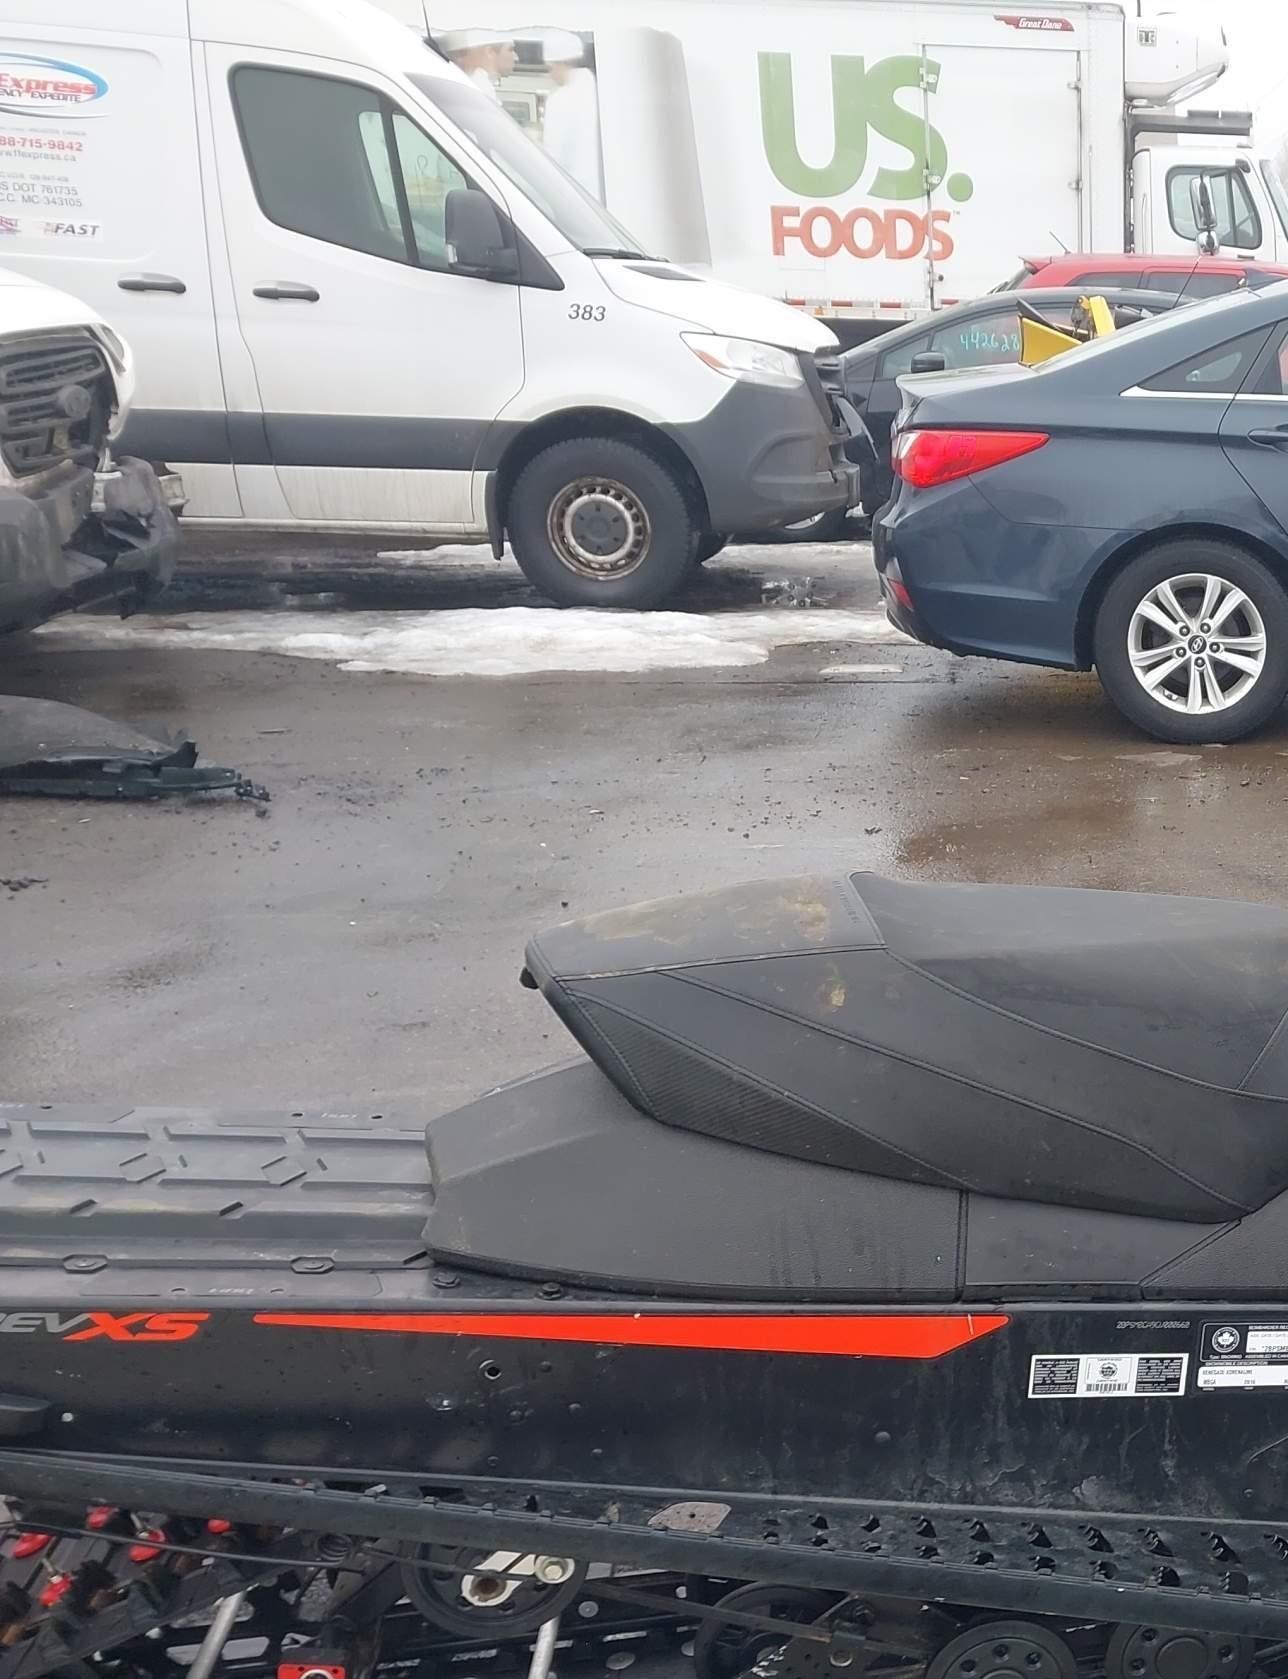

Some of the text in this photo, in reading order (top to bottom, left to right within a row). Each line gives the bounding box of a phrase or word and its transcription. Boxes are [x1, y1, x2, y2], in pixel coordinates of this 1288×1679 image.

[1018, 17, 1042, 29] Great
[13, 182, 36, 193] DOT
[54, 222, 100, 236] FAST
[770, 205, 955, 261] FOODS
[567, 303, 607, 322] 383
[960, 331, 1020, 353] 442628
